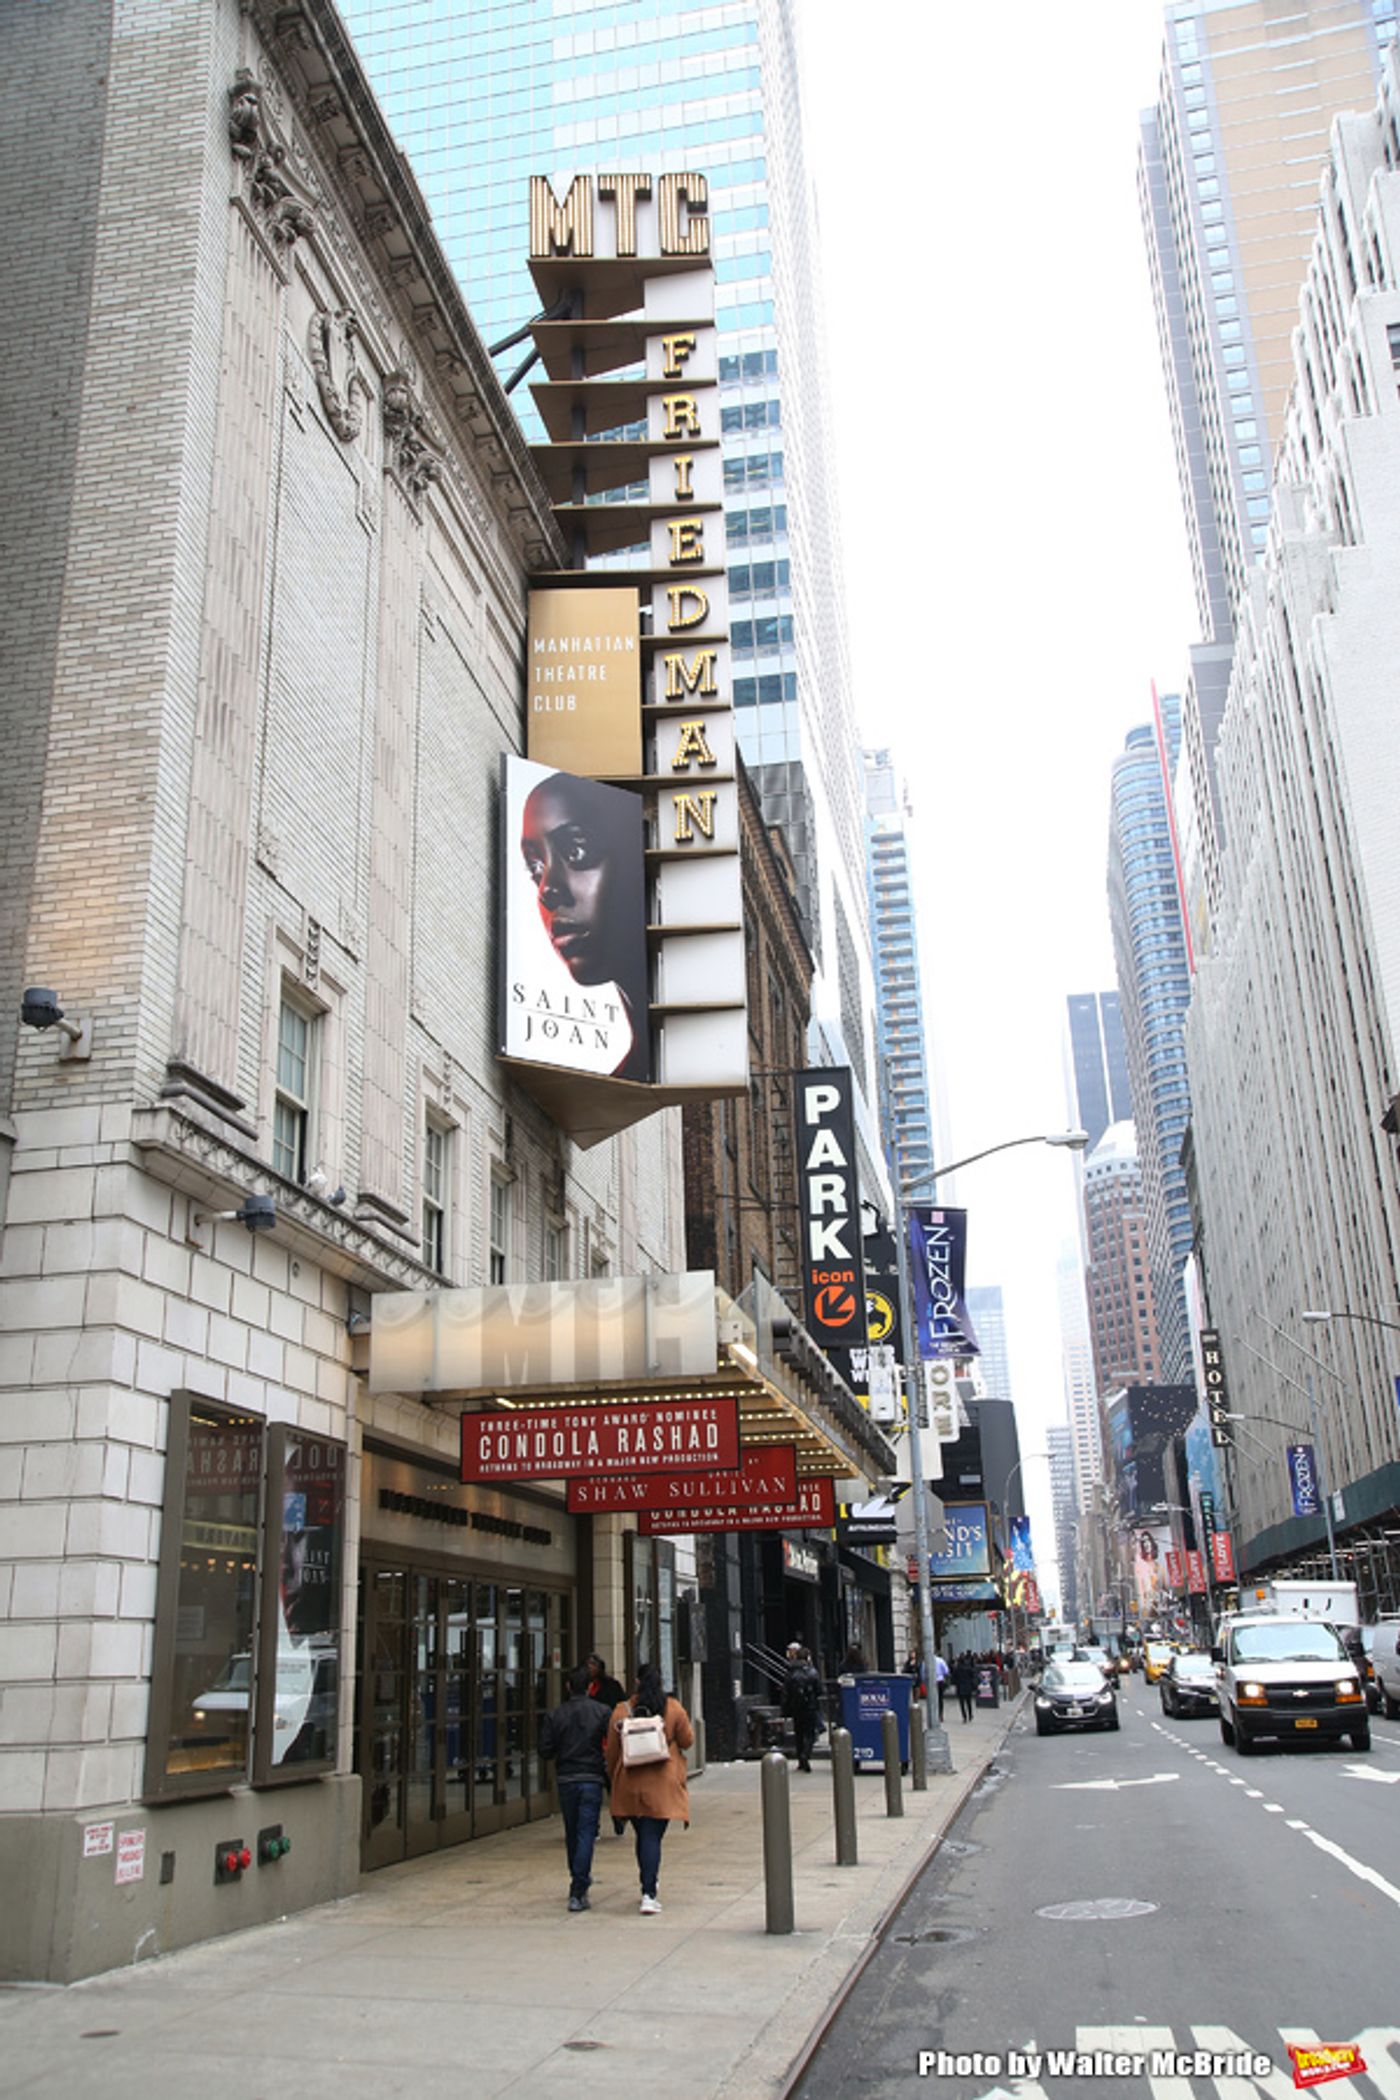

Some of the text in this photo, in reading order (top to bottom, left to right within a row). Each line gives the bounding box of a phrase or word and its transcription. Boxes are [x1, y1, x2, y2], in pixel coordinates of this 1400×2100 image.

[529, 172, 709, 259] MTC
[662, 333, 717, 843] FRIEDMAN
[533, 636, 636, 654] MANHATTAN
[535, 664, 608, 683] THEATRE
[533, 695, 577, 713] CLUB
[512, 982, 620, 1023] SAINT
[525, 1015, 609, 1050] JOAN
[804, 1084, 853, 1262] PARK
[811, 1268, 856, 1285] icon
[922, 1225, 965, 1340] FROZEN
[1205, 1350, 1230, 1444] HOTEL
[479, 1423, 719, 1460] CONDOLA RASHAD
[577, 1484, 649, 1502] SHAW
[669, 1477, 786, 1497] SULLIVAN
